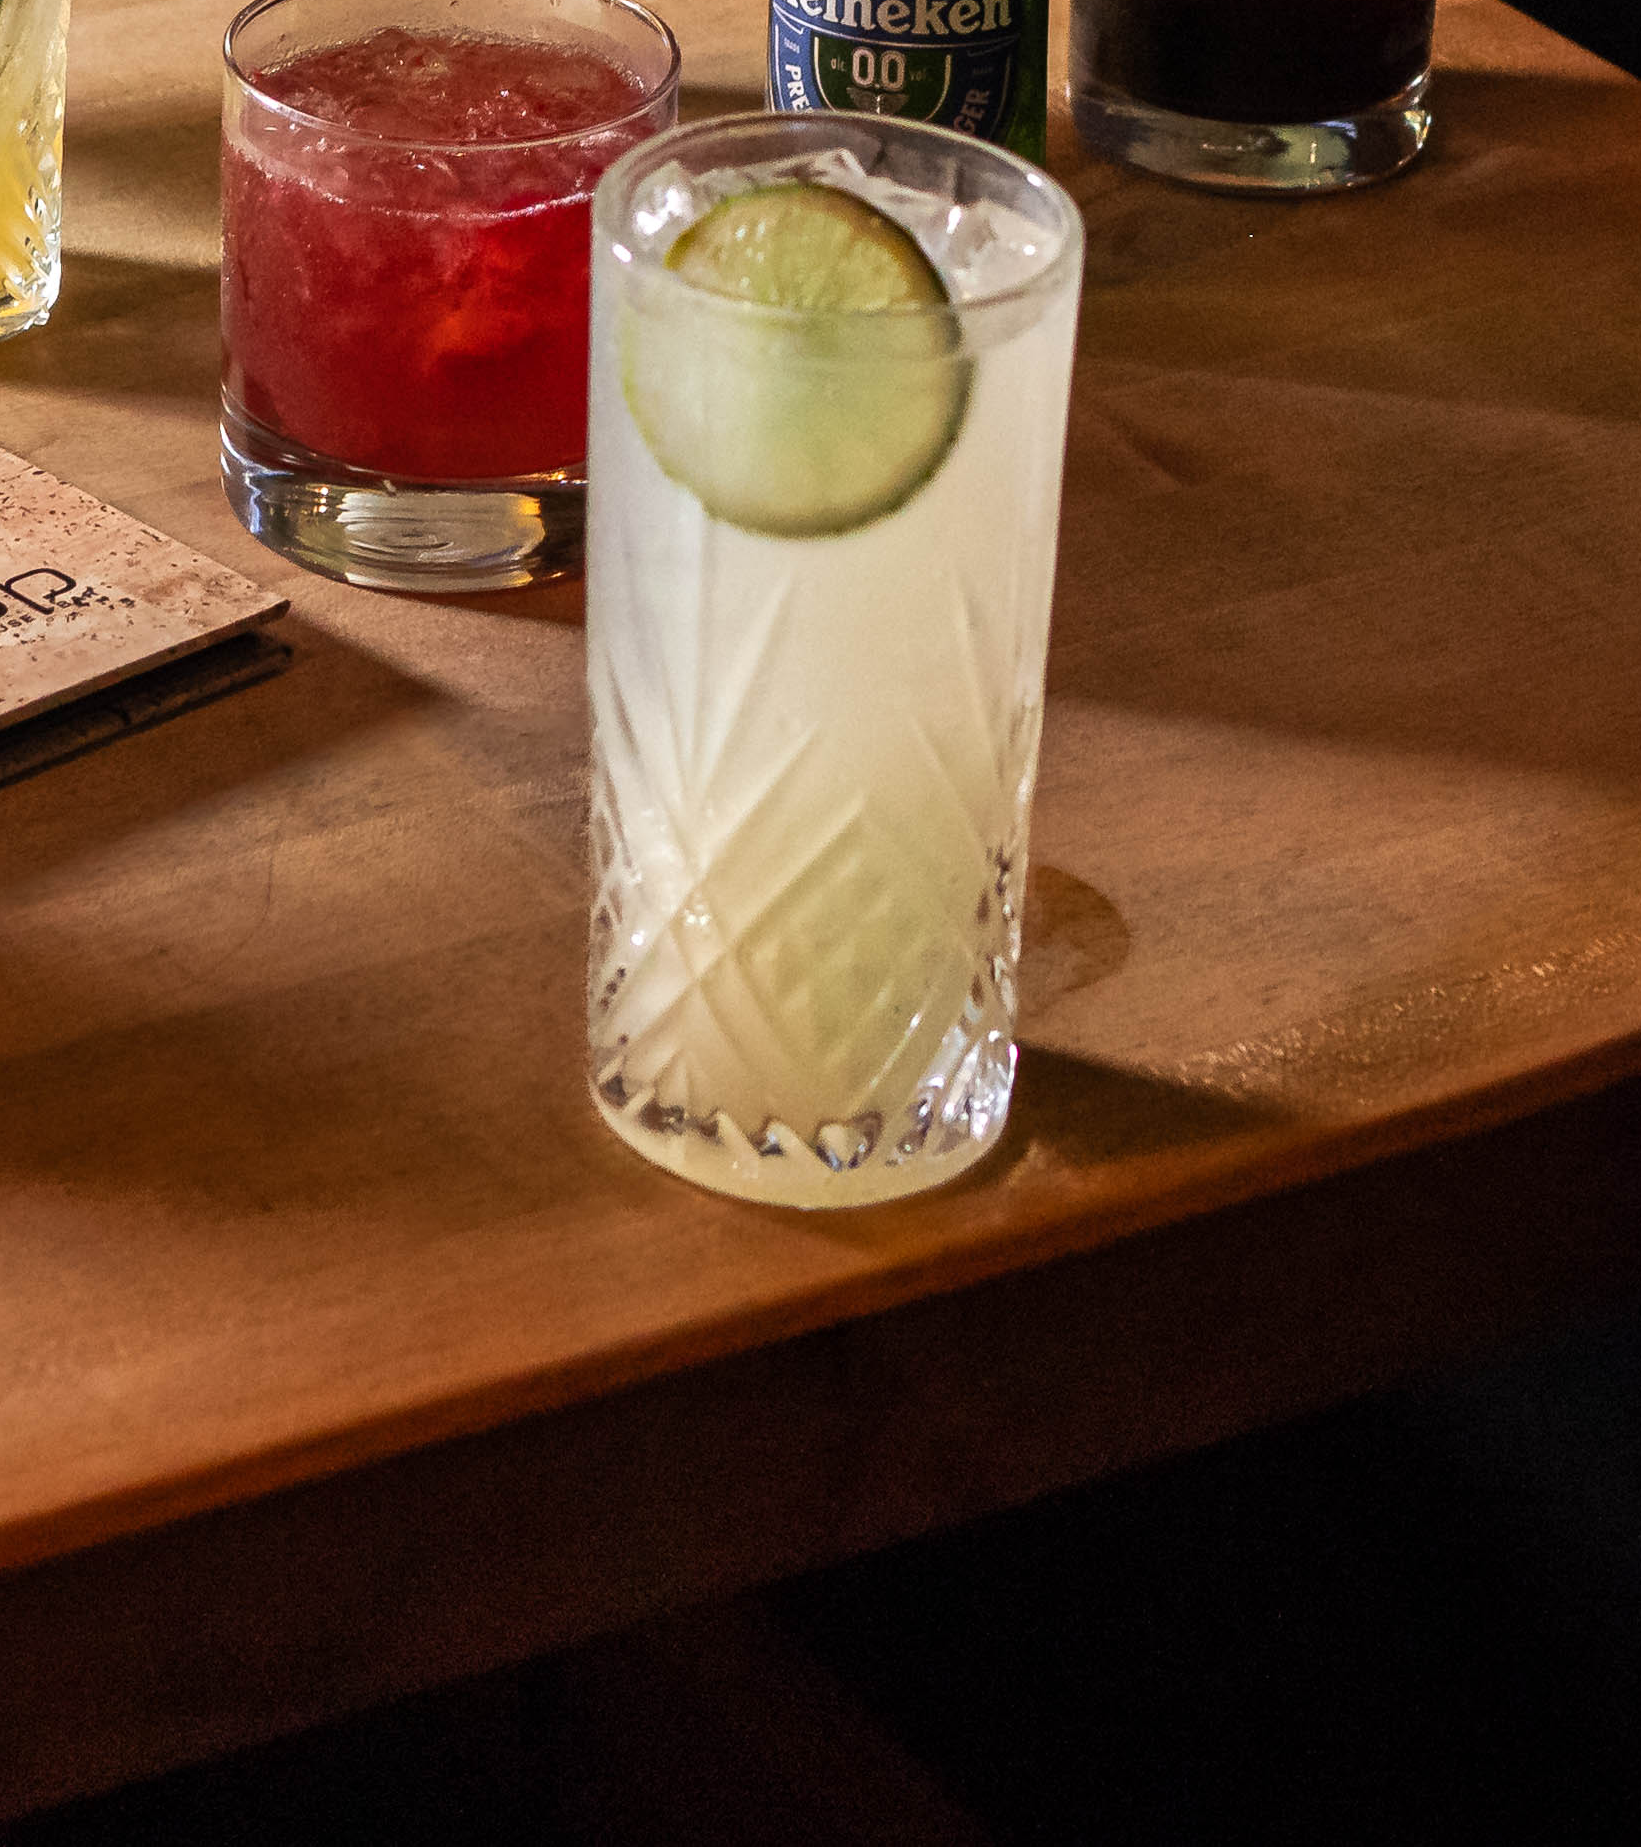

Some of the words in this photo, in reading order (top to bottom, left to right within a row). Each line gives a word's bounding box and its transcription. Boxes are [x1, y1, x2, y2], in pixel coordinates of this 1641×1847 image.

[783, 64, 816, 112] PRE
[851, 46, 907, 91] 0.0
[952, 89, 991, 135] GER
